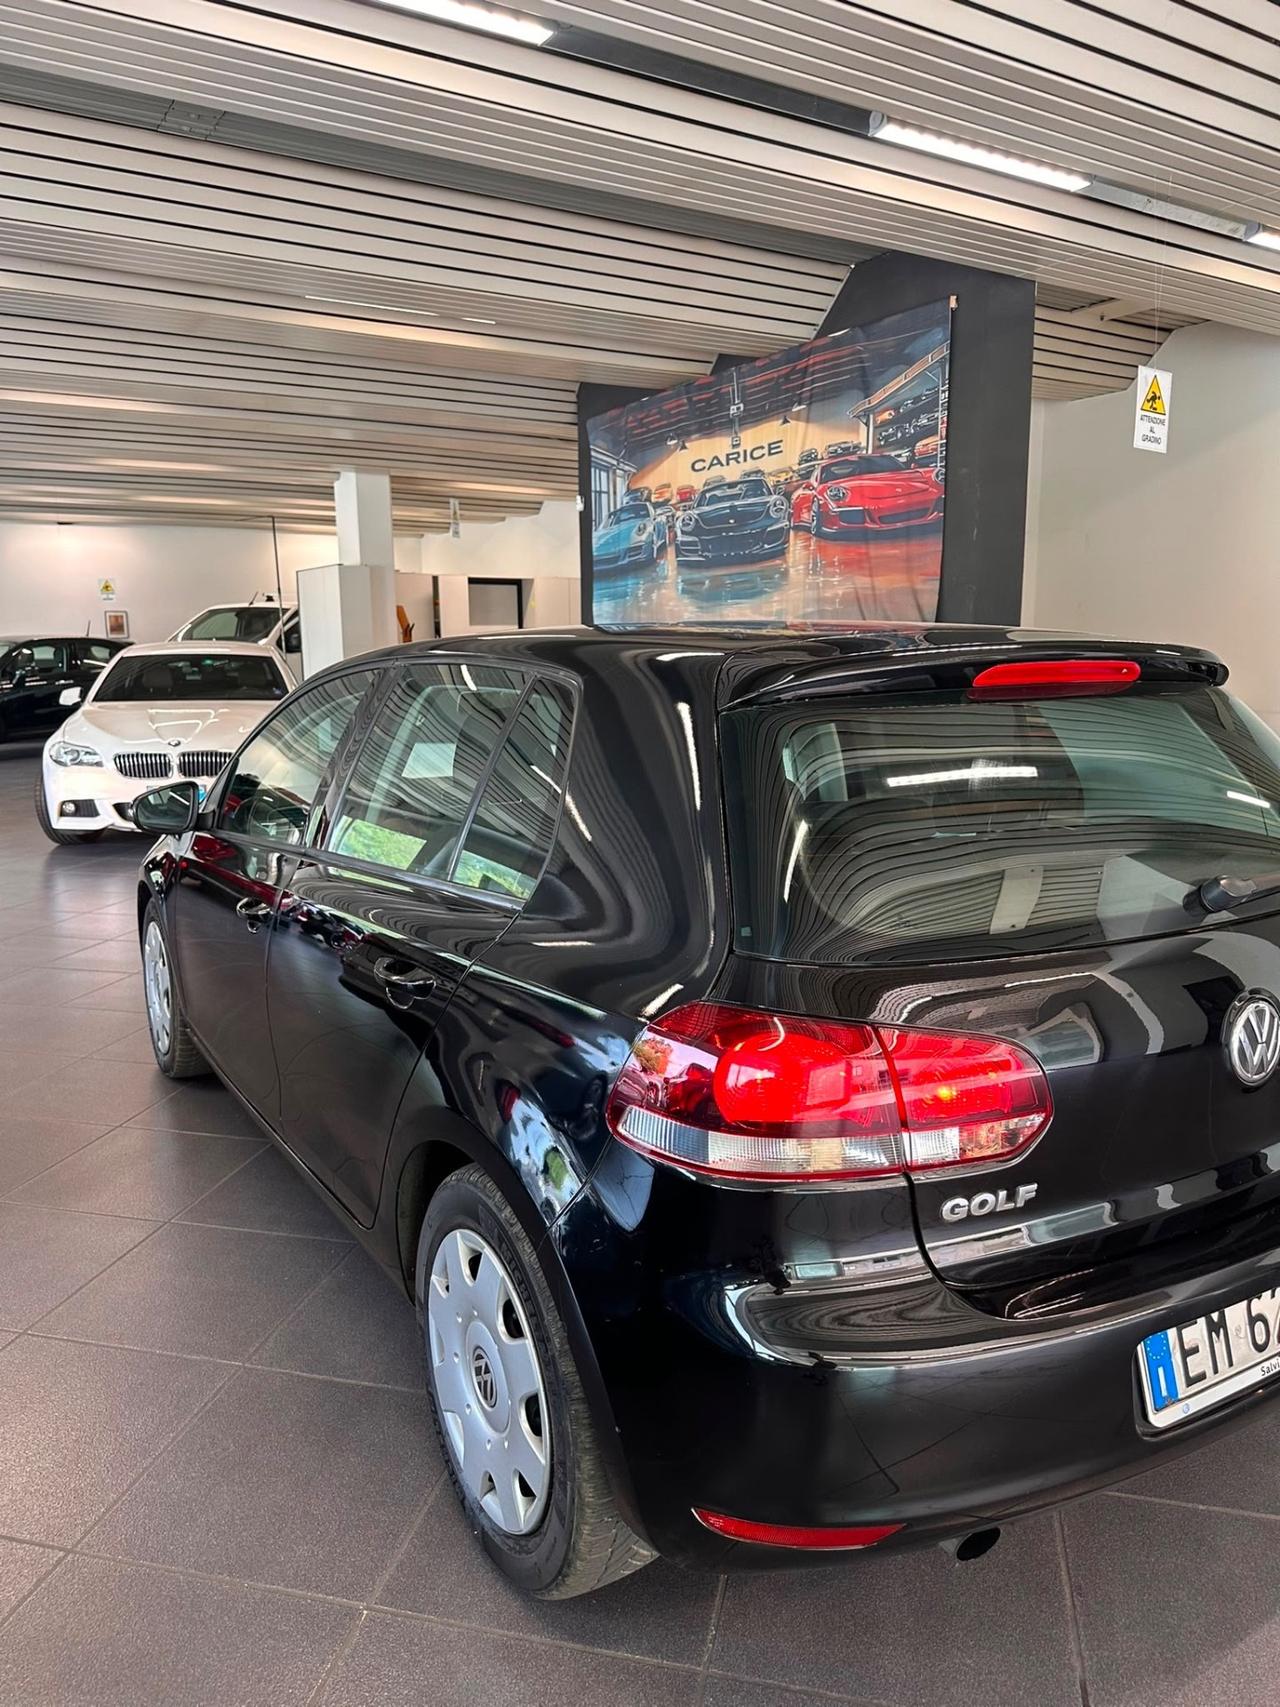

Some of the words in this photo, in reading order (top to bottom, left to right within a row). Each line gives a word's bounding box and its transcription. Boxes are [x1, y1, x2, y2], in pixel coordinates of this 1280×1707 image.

[1140, 414, 1166, 426] ATTENZIONE
[1141, 434, 1162, 445] GRADINO
[691, 440, 783, 472] CARICE
[941, 1183, 1038, 1222] GOLF
[1176, 1309, 1234, 1388] EM
